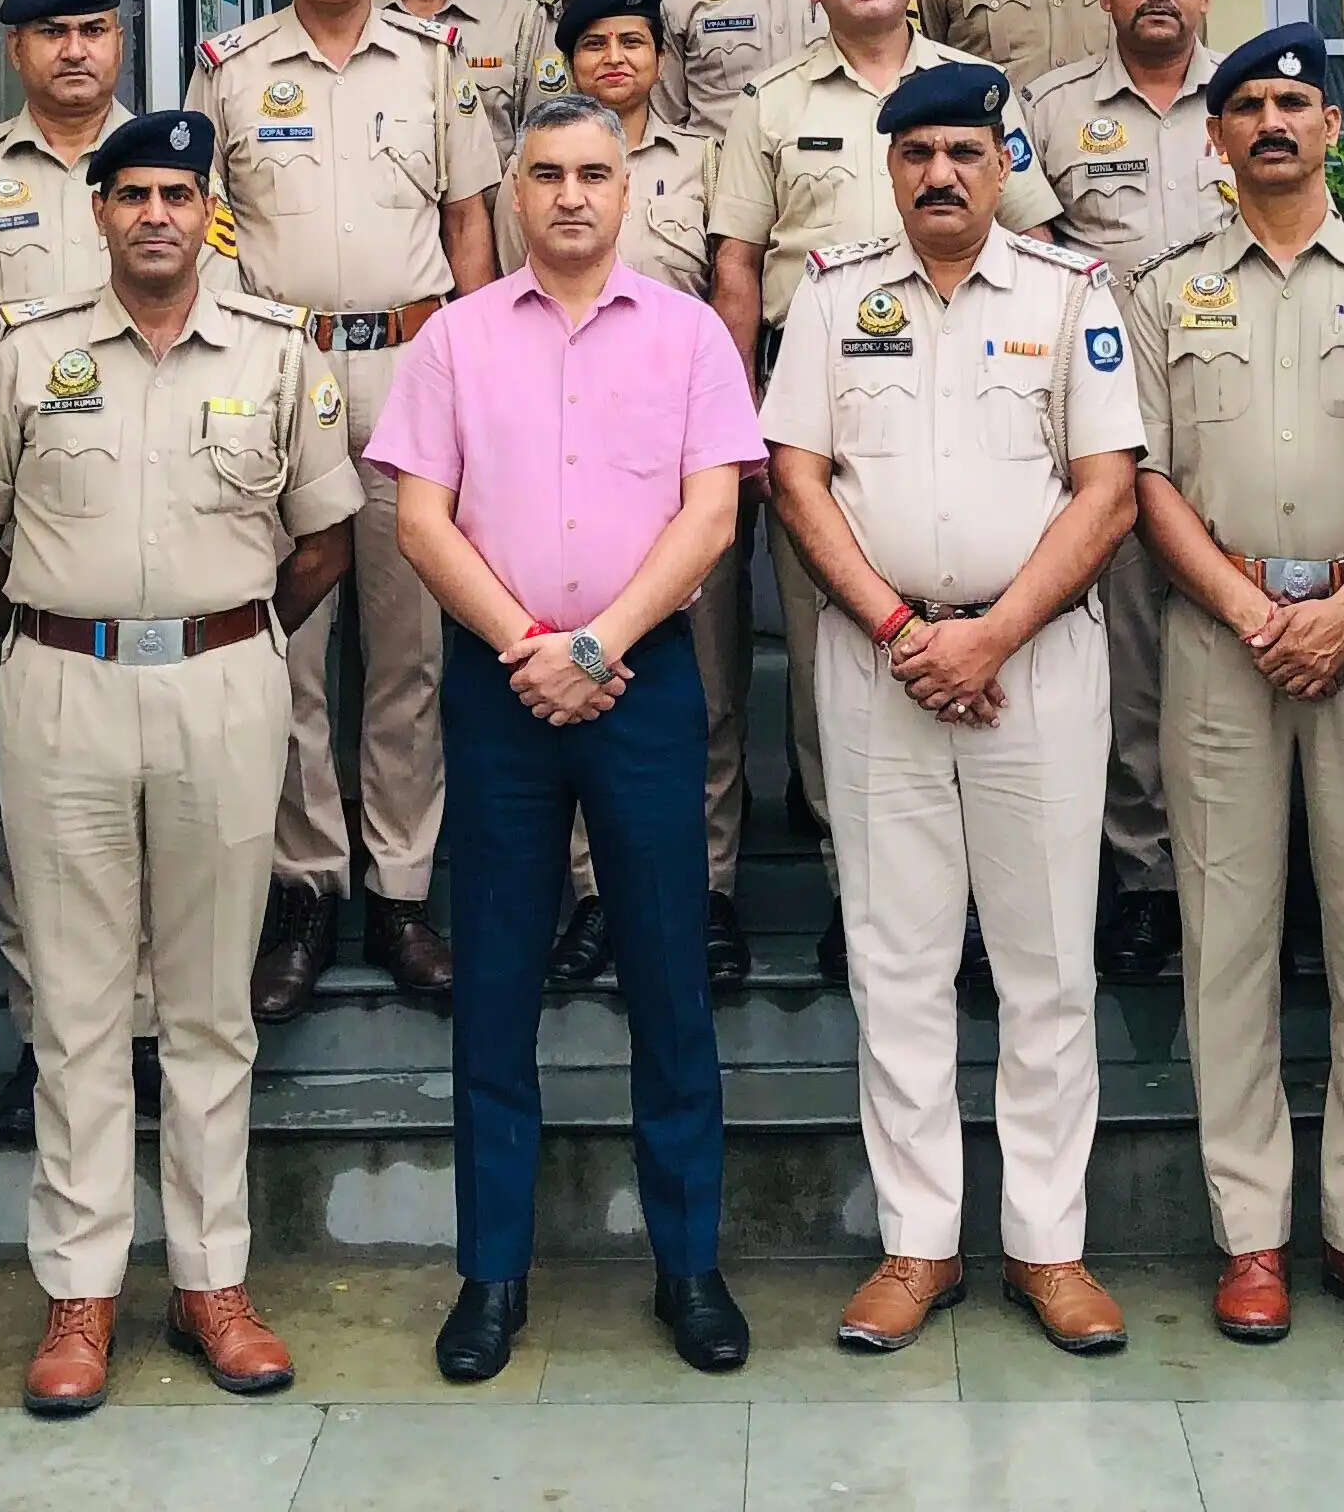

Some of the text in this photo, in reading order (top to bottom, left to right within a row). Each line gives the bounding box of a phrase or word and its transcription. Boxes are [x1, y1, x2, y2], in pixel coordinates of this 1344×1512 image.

[260, 128, 312, 137] GOPAL SINGH
[883, 341, 912, 352] SINGH
[40, 398, 102, 410] RAJESH KUMAR
